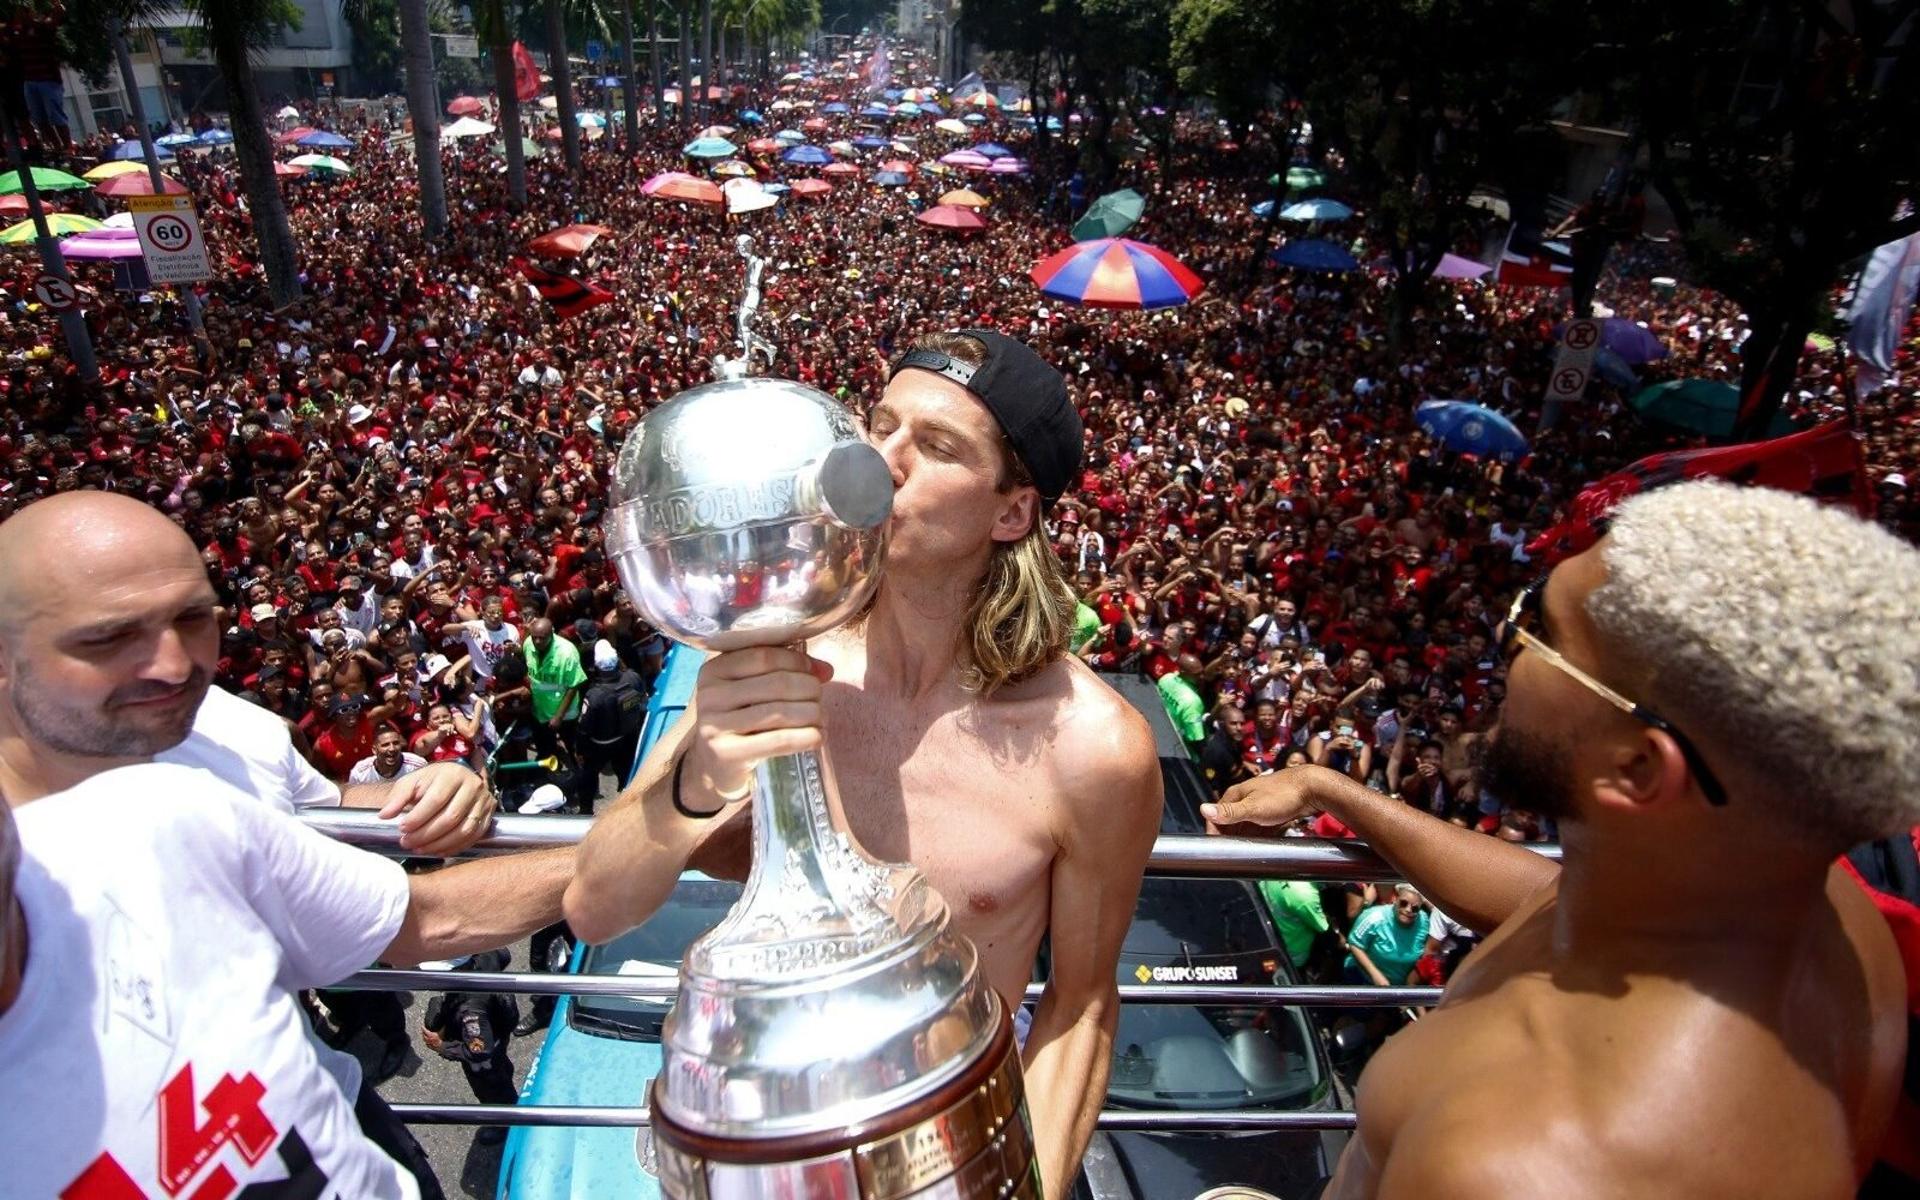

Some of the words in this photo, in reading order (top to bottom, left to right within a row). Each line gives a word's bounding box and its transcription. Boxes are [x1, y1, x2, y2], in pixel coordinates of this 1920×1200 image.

[157, 225, 183, 240] 60
[1152, 966, 1195, 981] GRUPO
[1194, 966, 1238, 981] SUNSET
